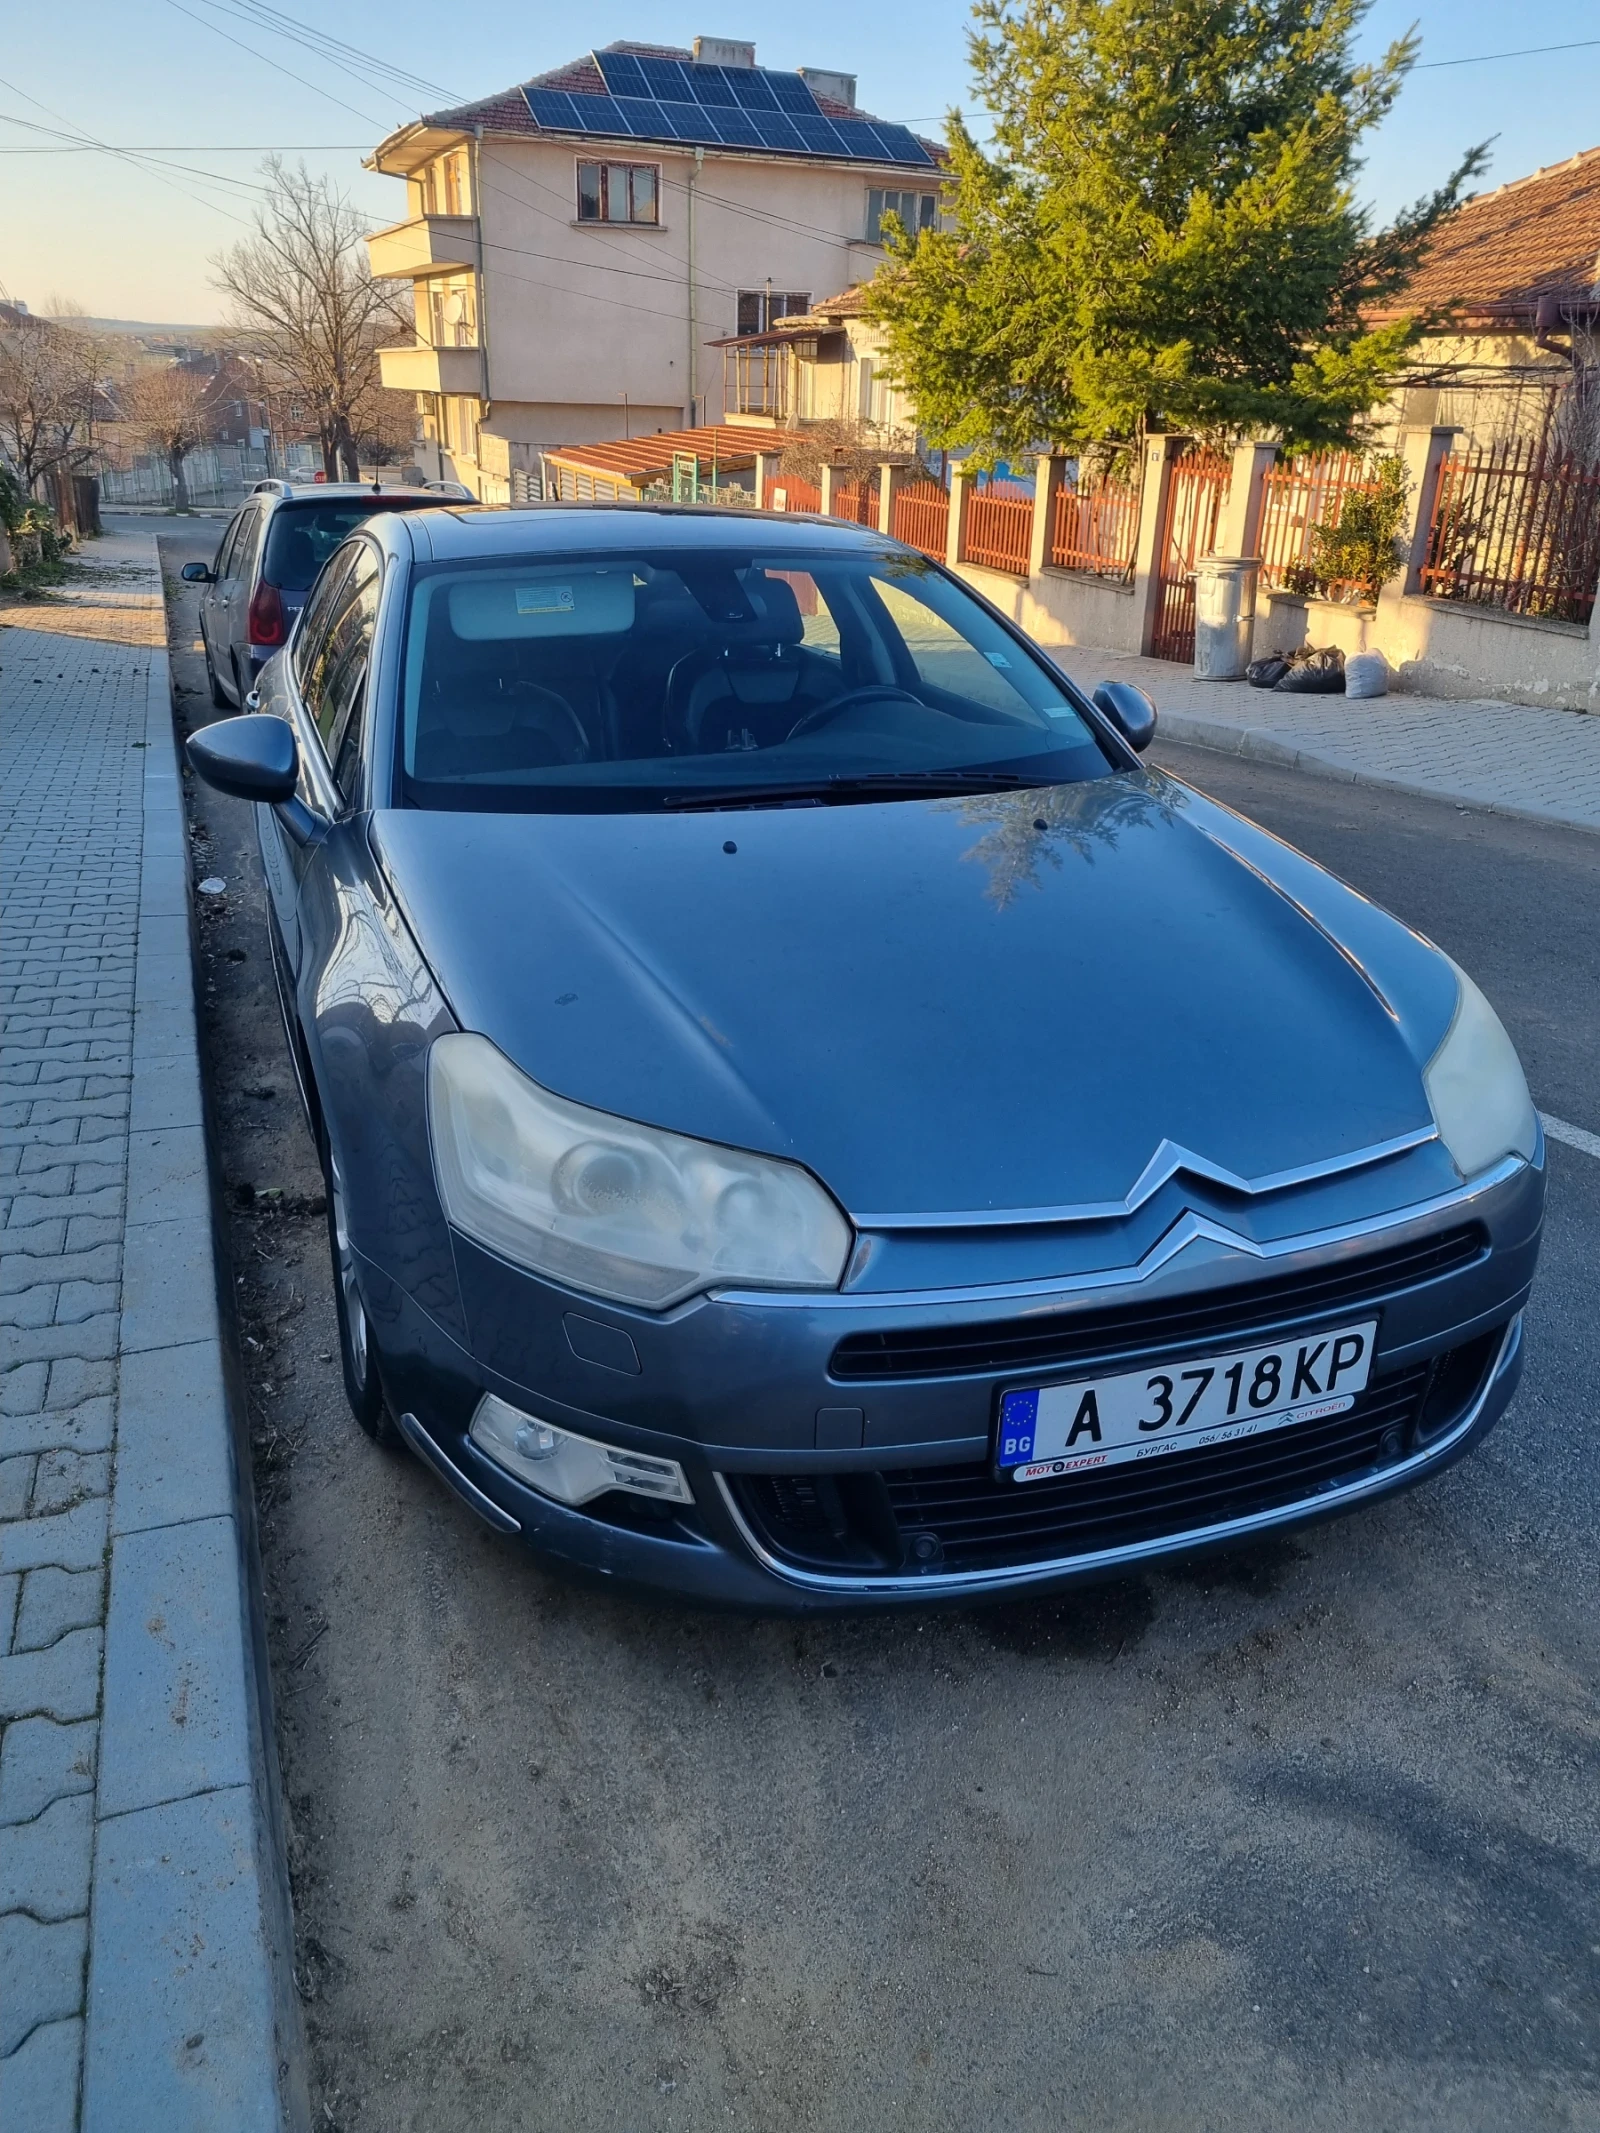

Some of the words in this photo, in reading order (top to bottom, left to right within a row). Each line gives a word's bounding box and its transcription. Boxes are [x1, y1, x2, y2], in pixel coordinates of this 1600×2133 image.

[1065, 1389, 1102, 1447] A
[1004, 1436, 1031, 1454] BG
[1136, 1442, 1177, 1458] БУРГАС
